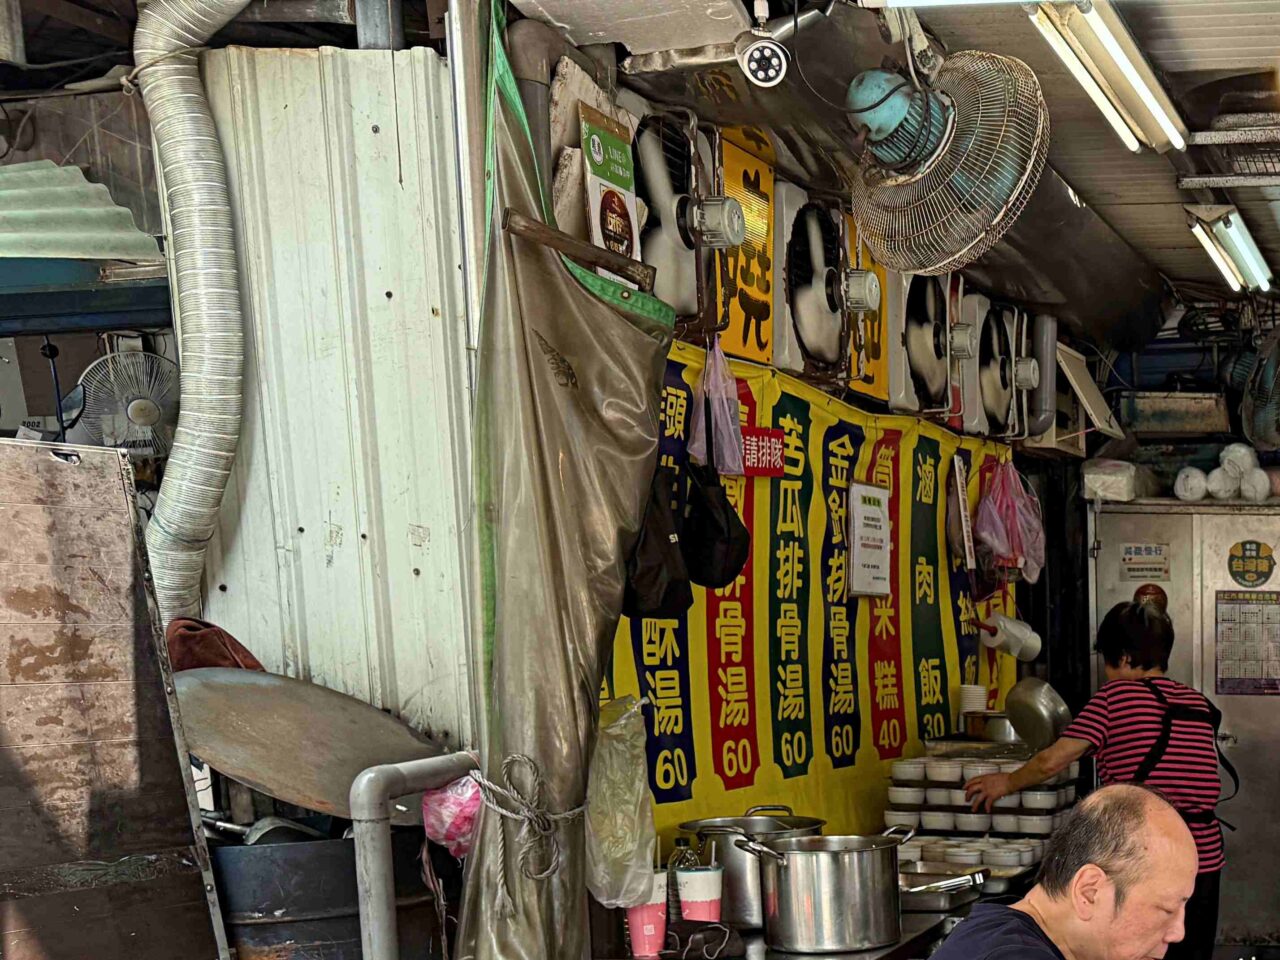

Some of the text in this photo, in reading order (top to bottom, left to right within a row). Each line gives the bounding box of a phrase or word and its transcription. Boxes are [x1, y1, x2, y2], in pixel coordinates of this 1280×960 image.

[741, 434, 784, 470] 請排隊
[776, 414, 806, 722] 苦瓜排骨湯
[872, 444, 900, 711] 筒米糕
[915, 453, 944, 705] 滷肉飯
[831, 724, 854, 758] 60
[878, 721, 901, 750] 40
[923, 712, 946, 740] 30
[722, 738, 753, 777] 60
[781, 731, 807, 767] 60
[655, 748, 688, 790] 60
